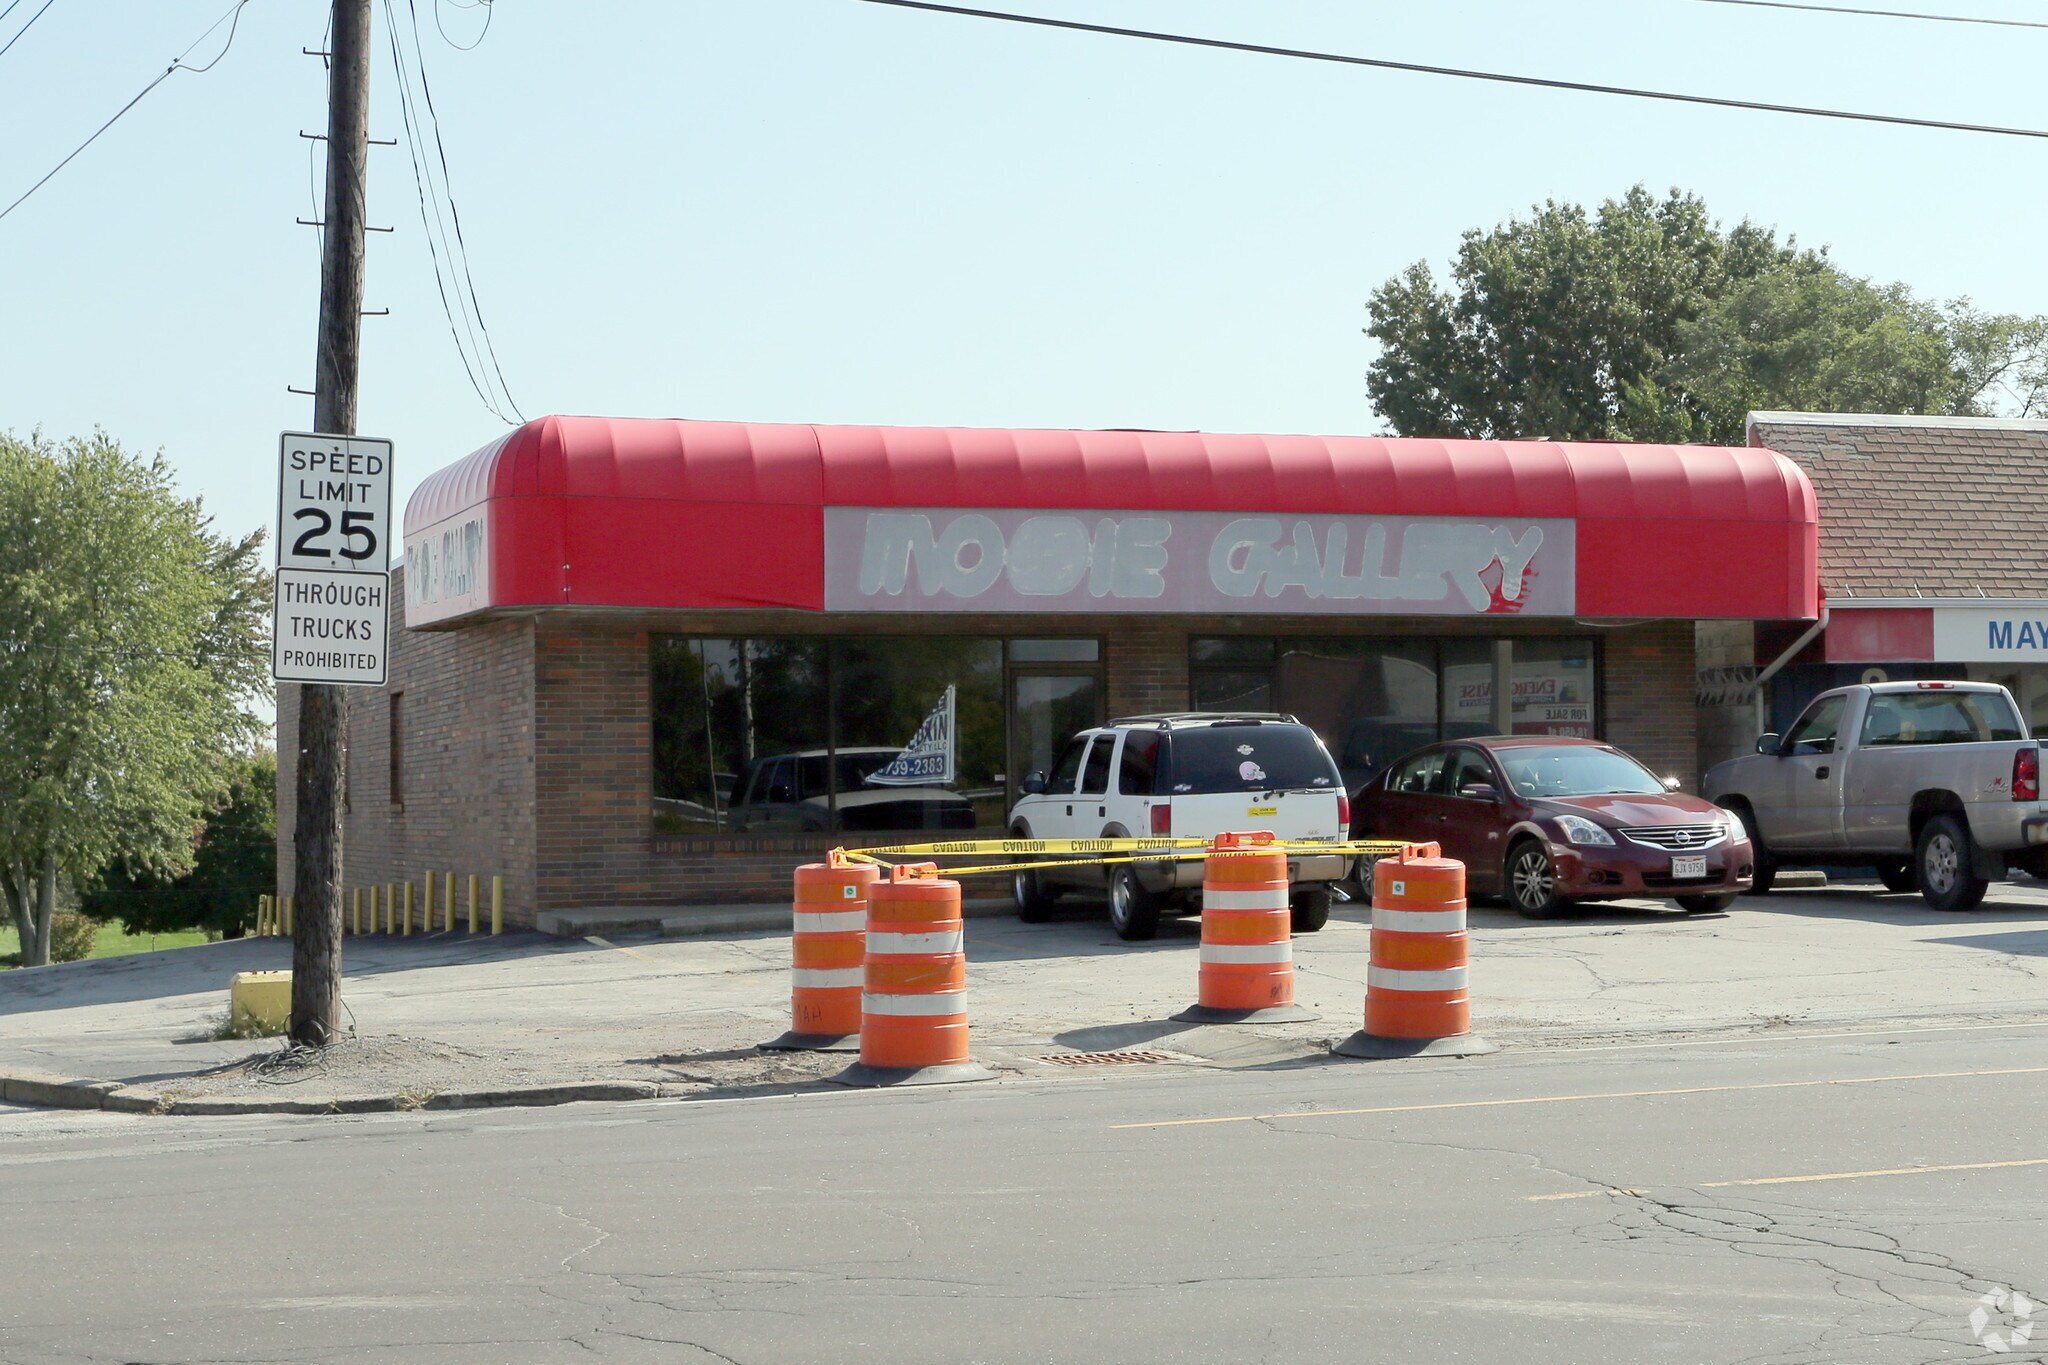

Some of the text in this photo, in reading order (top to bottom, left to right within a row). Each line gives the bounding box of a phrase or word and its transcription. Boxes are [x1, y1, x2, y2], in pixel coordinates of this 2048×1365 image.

[290, 450, 383, 475] SPEED
[300, 480, 372, 503] LIMIT
[292, 507, 377, 560] 25
[284, 582, 381, 607] THROUGH
[291, 616, 372, 640] TRUCKS
[1989, 621, 2048, 649] MAY
[284, 650, 376, 670] PROHIBITED
[1688, 862, 1705, 873] 9758
